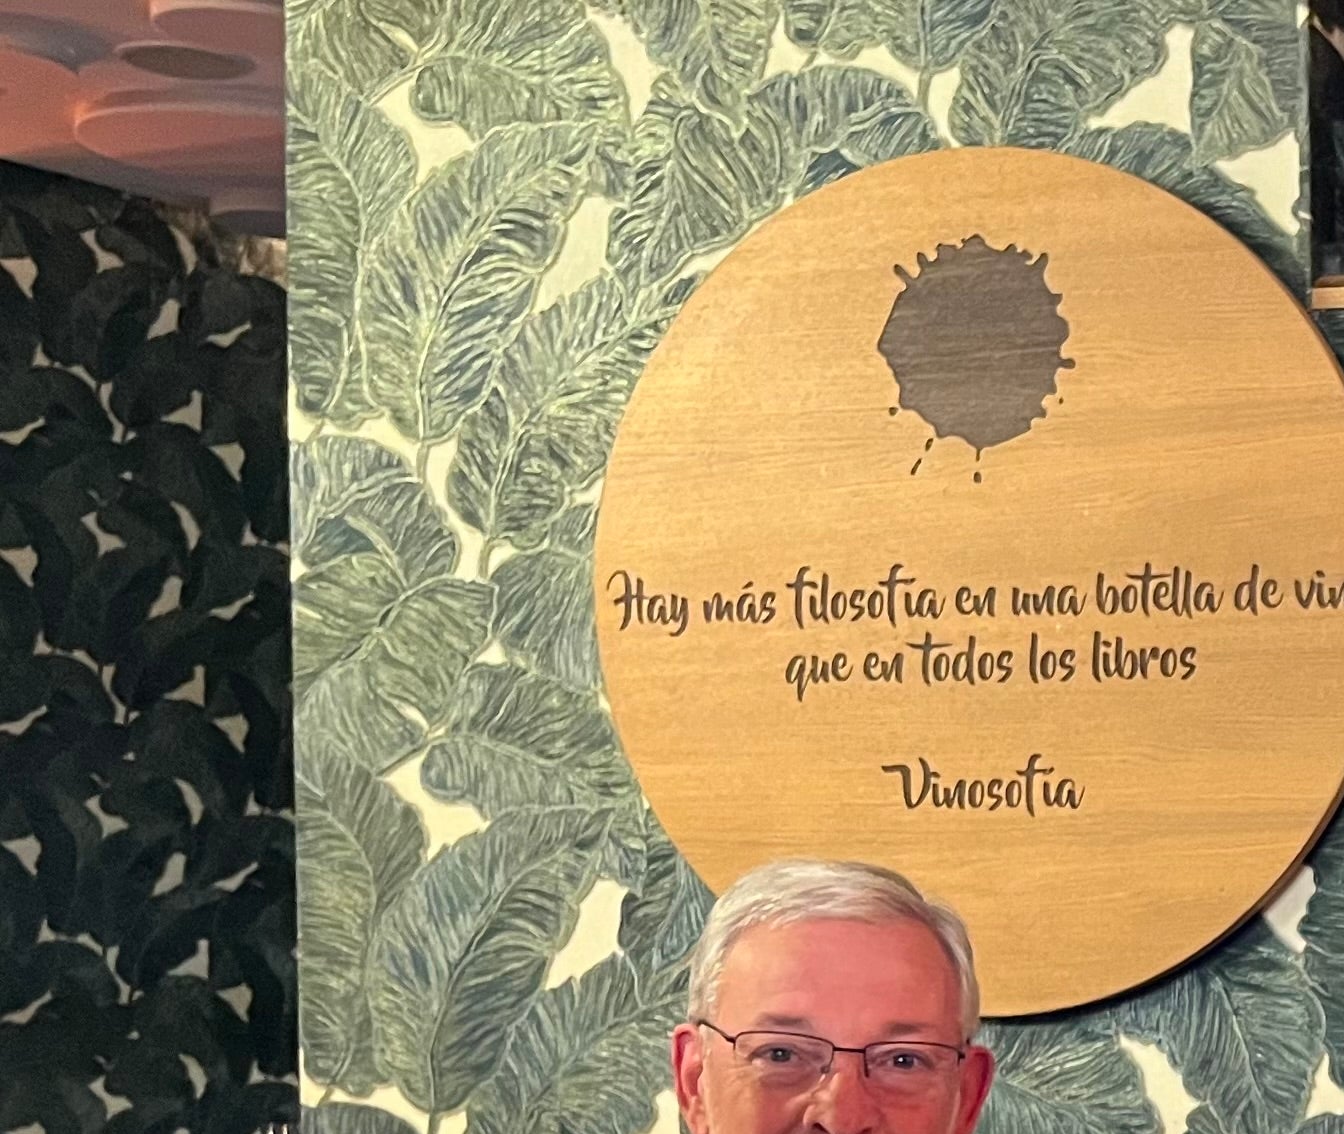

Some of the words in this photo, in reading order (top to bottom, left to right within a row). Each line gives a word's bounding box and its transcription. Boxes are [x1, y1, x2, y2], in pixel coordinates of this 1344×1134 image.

[606, 569, 690, 637] Hay
[702, 580, 777, 625] más
[954, 585, 998, 618] en
[1011, 584, 1088, 617] una
[1095, 561, 1225, 620] botella
[1233, 563, 1285, 617] de
[784, 650, 854, 703] que
[862, 651, 905, 684] en
[906, 630, 1014, 688] todos
[1028, 631, 1076, 685] los
[1091, 630, 1198, 684] libros
